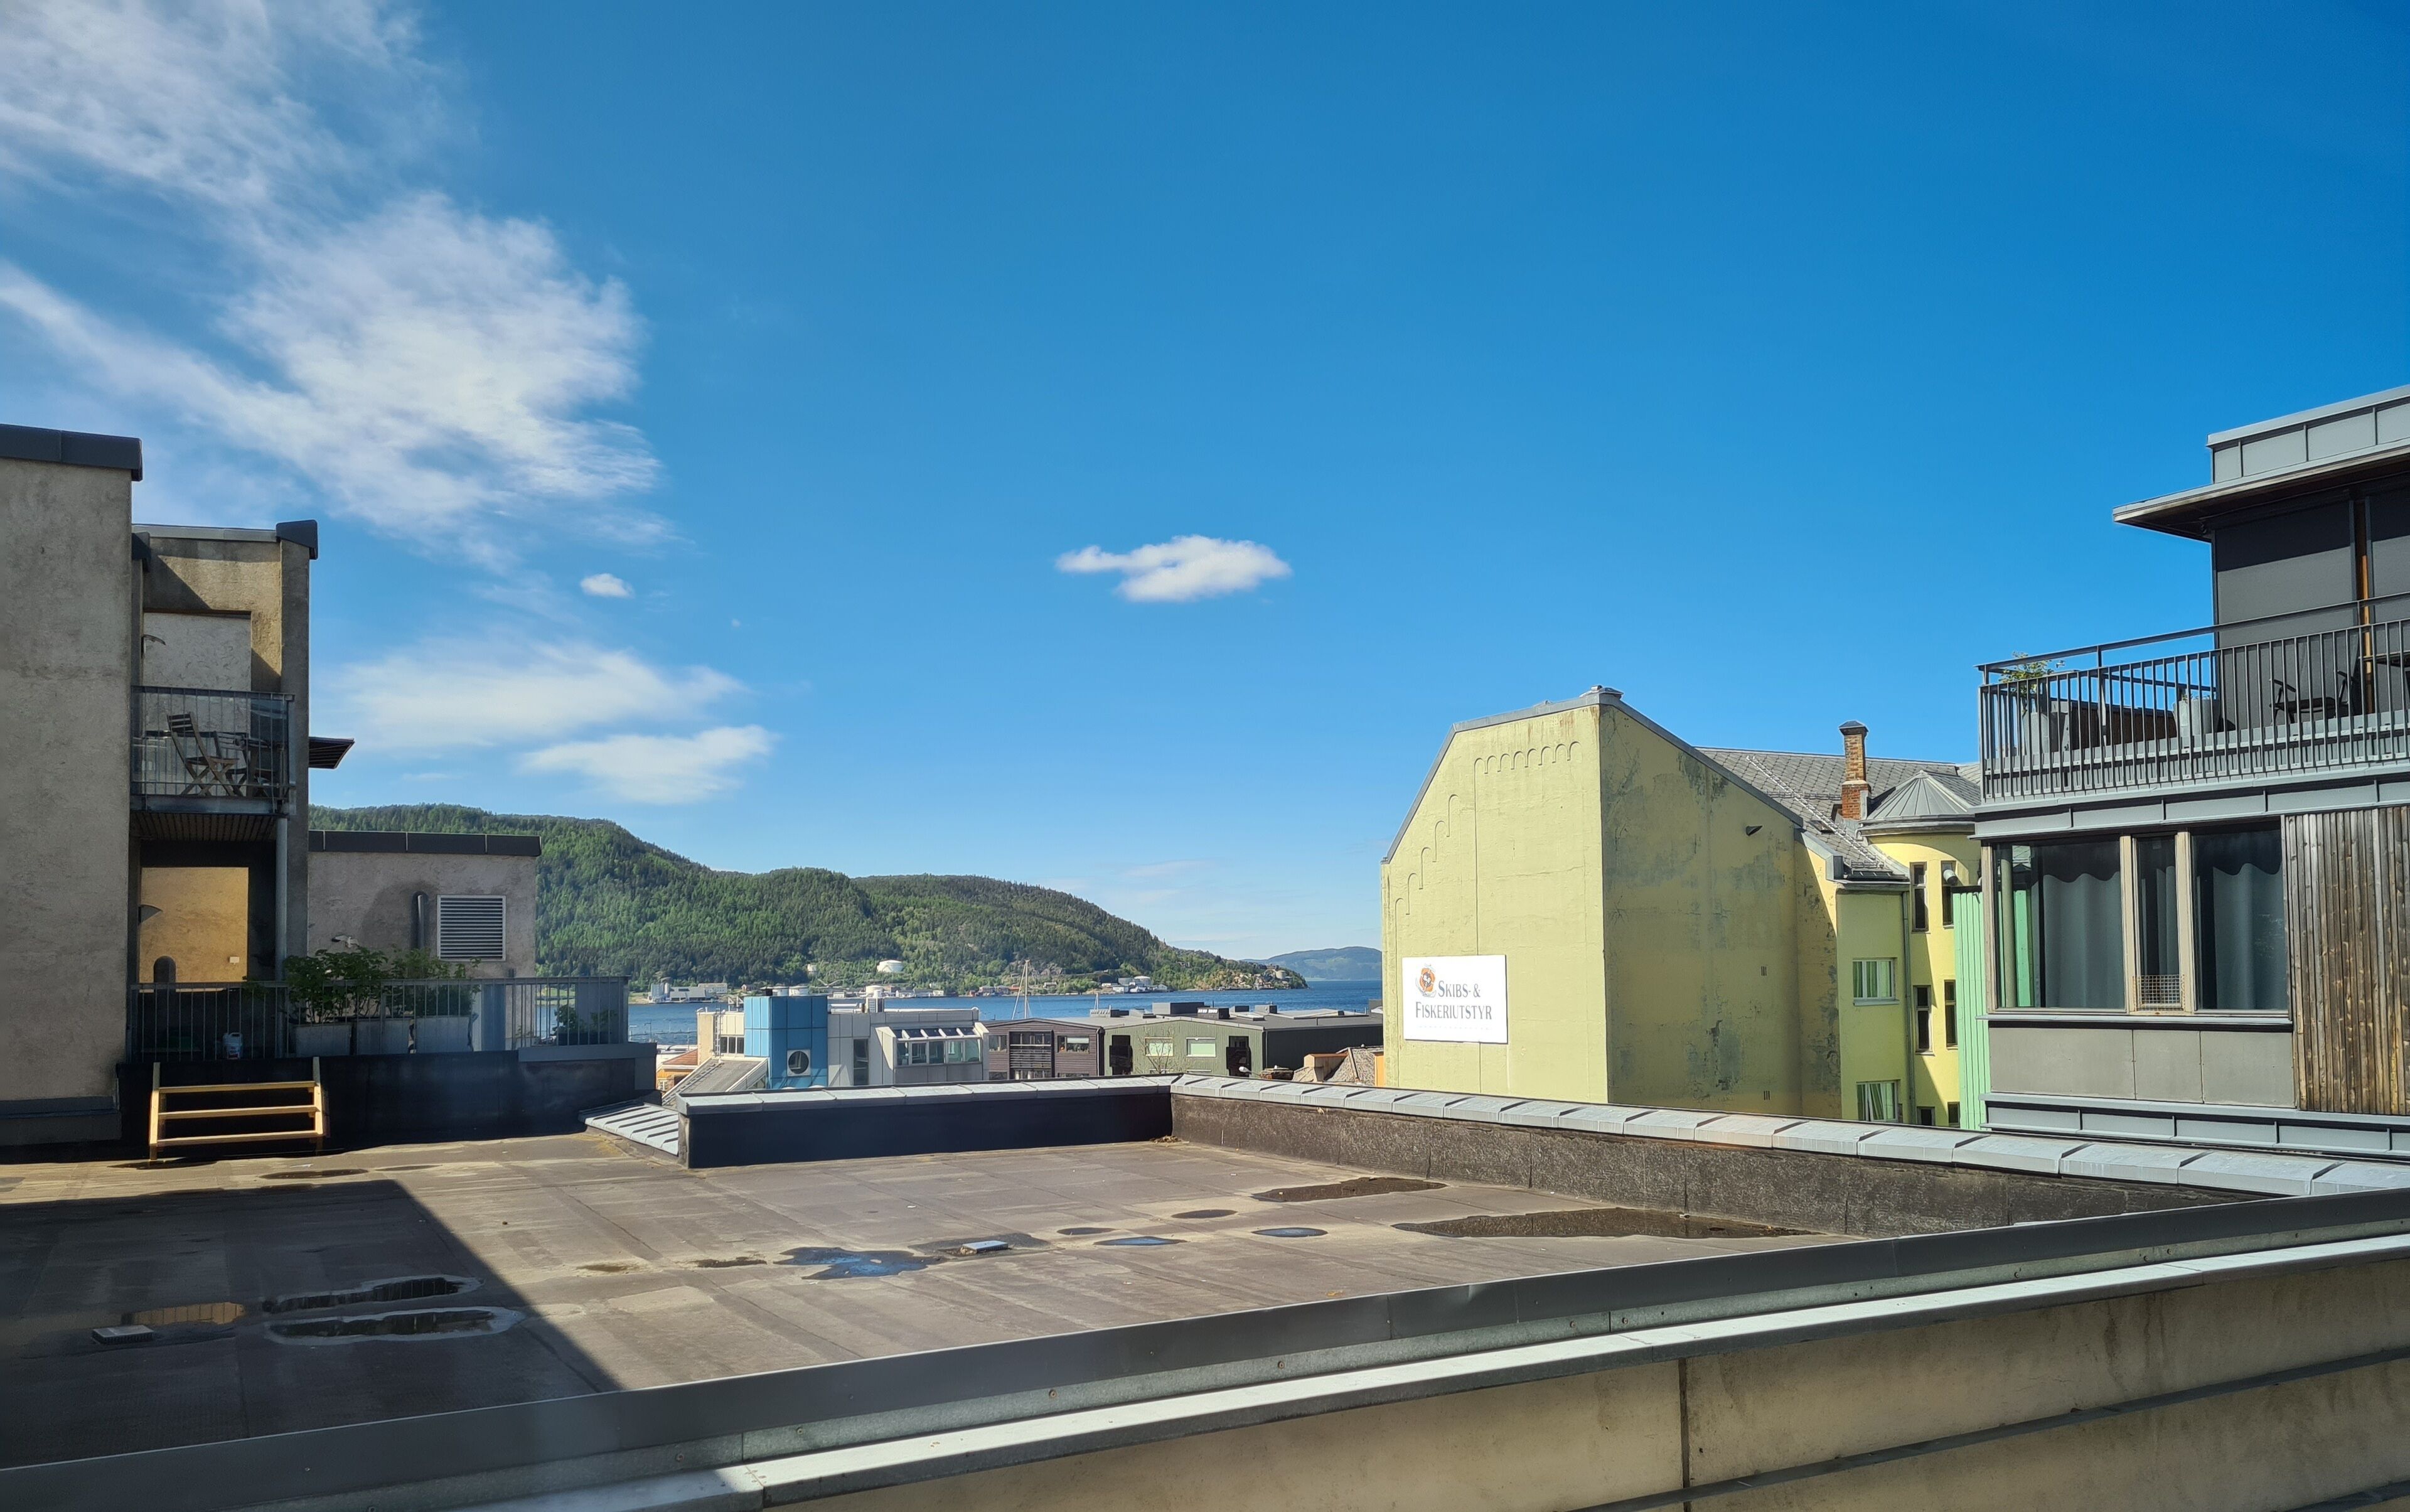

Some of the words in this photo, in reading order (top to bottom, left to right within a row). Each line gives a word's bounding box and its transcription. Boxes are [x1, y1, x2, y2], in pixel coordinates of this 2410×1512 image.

[1438, 980, 1471, 997] SKIBS-
[1473, 983, 1481, 997] &
[1415, 1001, 1492, 1020] FISKERIUTSTYR
